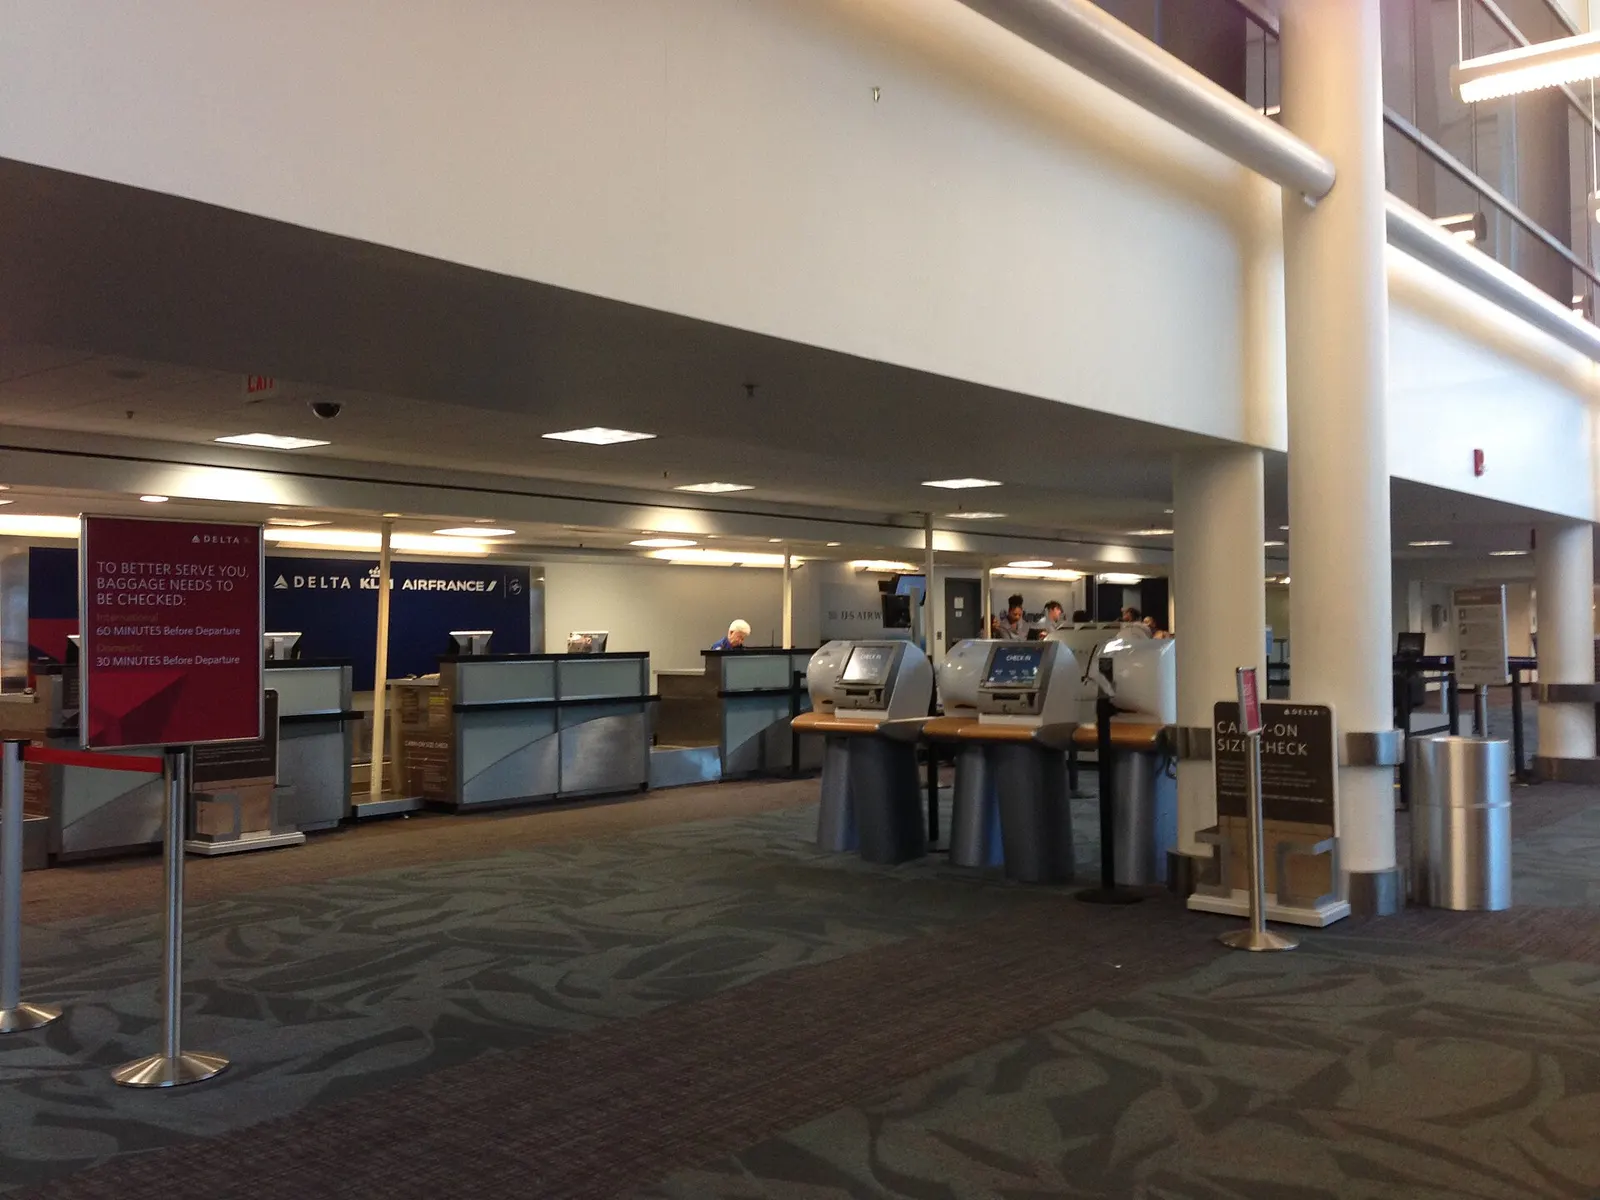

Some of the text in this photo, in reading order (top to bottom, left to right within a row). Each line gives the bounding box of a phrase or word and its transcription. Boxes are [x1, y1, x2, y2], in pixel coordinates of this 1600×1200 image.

[204, 535, 240, 544] DELTA
[97, 561, 249, 579] TO BETTER SERVE YOU,
[97, 577, 234, 592] BAGGAGE NEEDS TO
[294, 576, 351, 590] DELTA
[402, 579, 484, 592] AIRFRANCE
[97, 593, 186, 606] BE CHECKED:
[96, 626, 240, 637] 60 MINUTES Before Departure
[96, 655, 240, 667] 30 MINUTES Before Departure
[1216, 721, 1298, 737] CAY-ON
